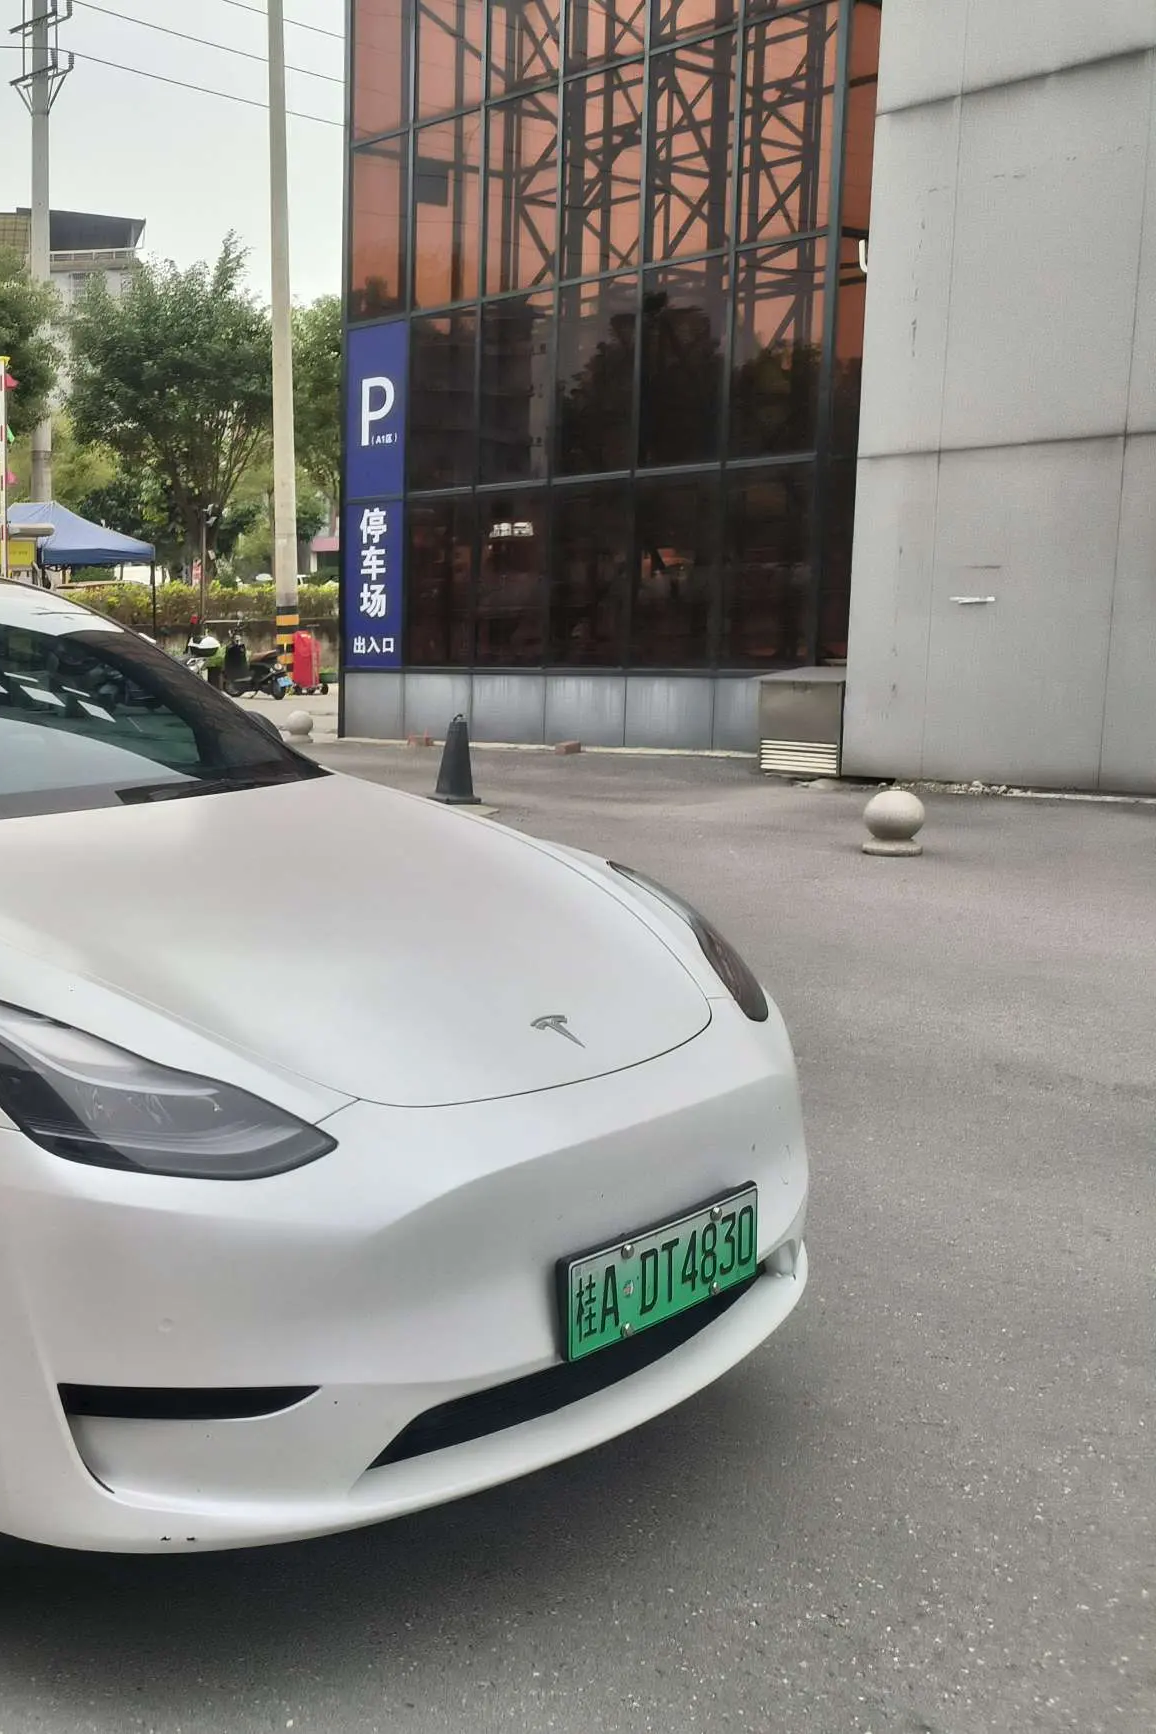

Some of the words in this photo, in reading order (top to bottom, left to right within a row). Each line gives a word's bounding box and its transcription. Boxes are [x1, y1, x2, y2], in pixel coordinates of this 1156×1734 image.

[361, 376, 395, 447] P
[359, 507, 388, 618] 停车场
[352, 635, 395, 654] 出入口
